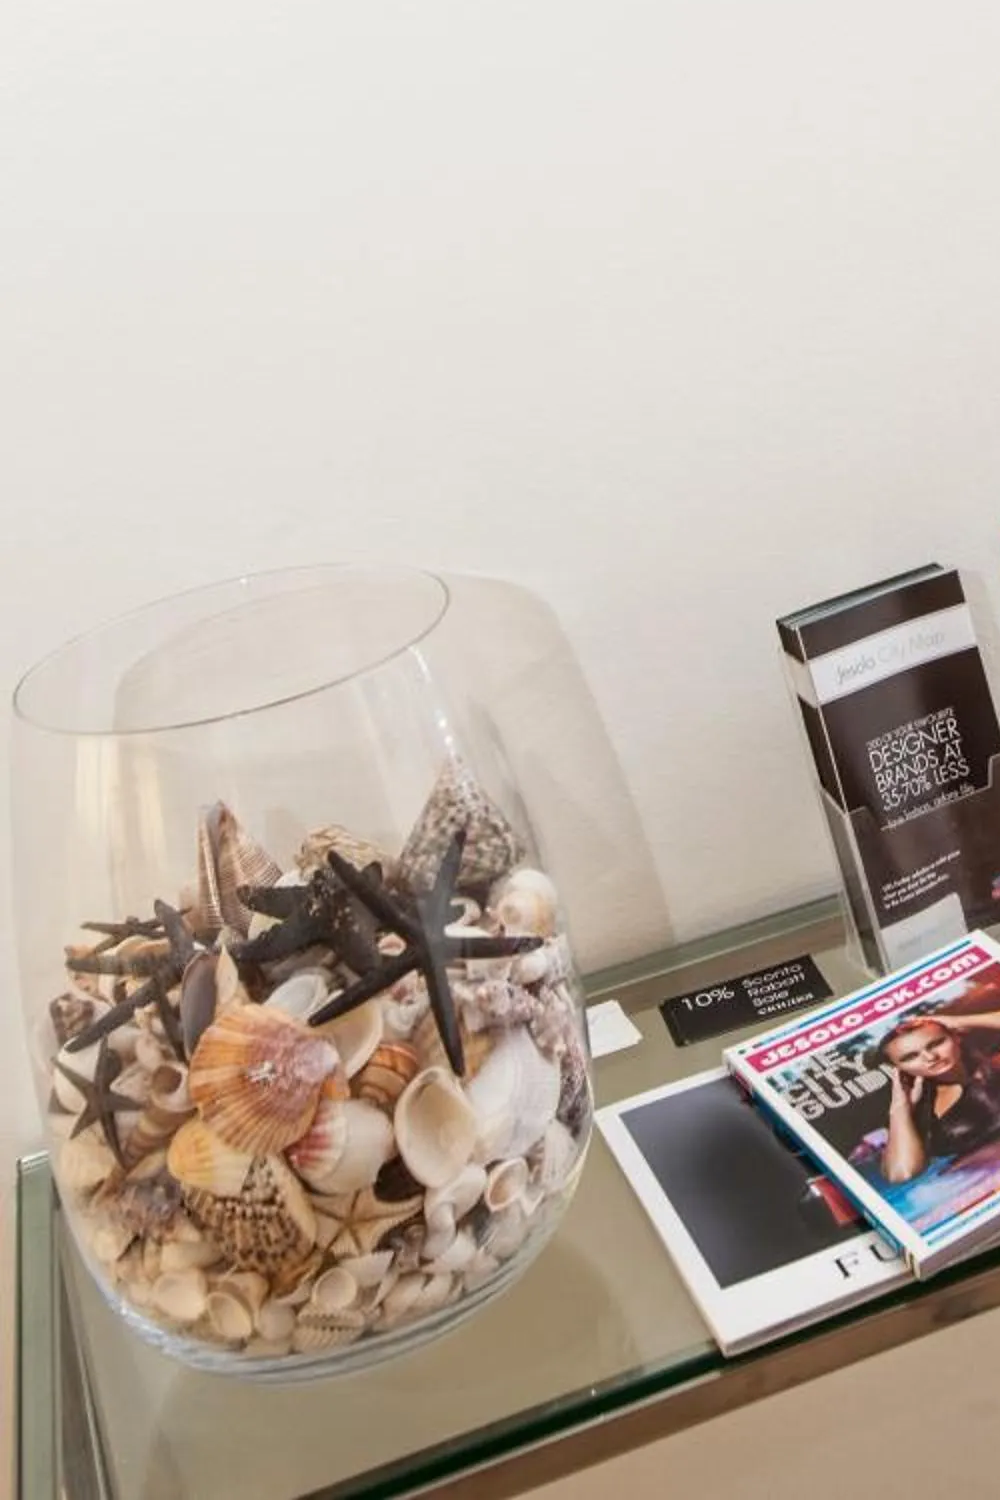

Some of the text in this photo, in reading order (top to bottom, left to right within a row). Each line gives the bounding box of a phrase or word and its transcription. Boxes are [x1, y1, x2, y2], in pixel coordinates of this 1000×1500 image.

[869, 717, 961, 773] DESIGNER
[875, 738, 962, 793] BRANDS AT
[933, 757, 970, 785] LESS
[681, 985, 735, 1011] 10%
[742, 963, 803, 989] Sconto
[747, 973, 806, 998] Rabatt
[752, 989, 790, 1008] Sale
